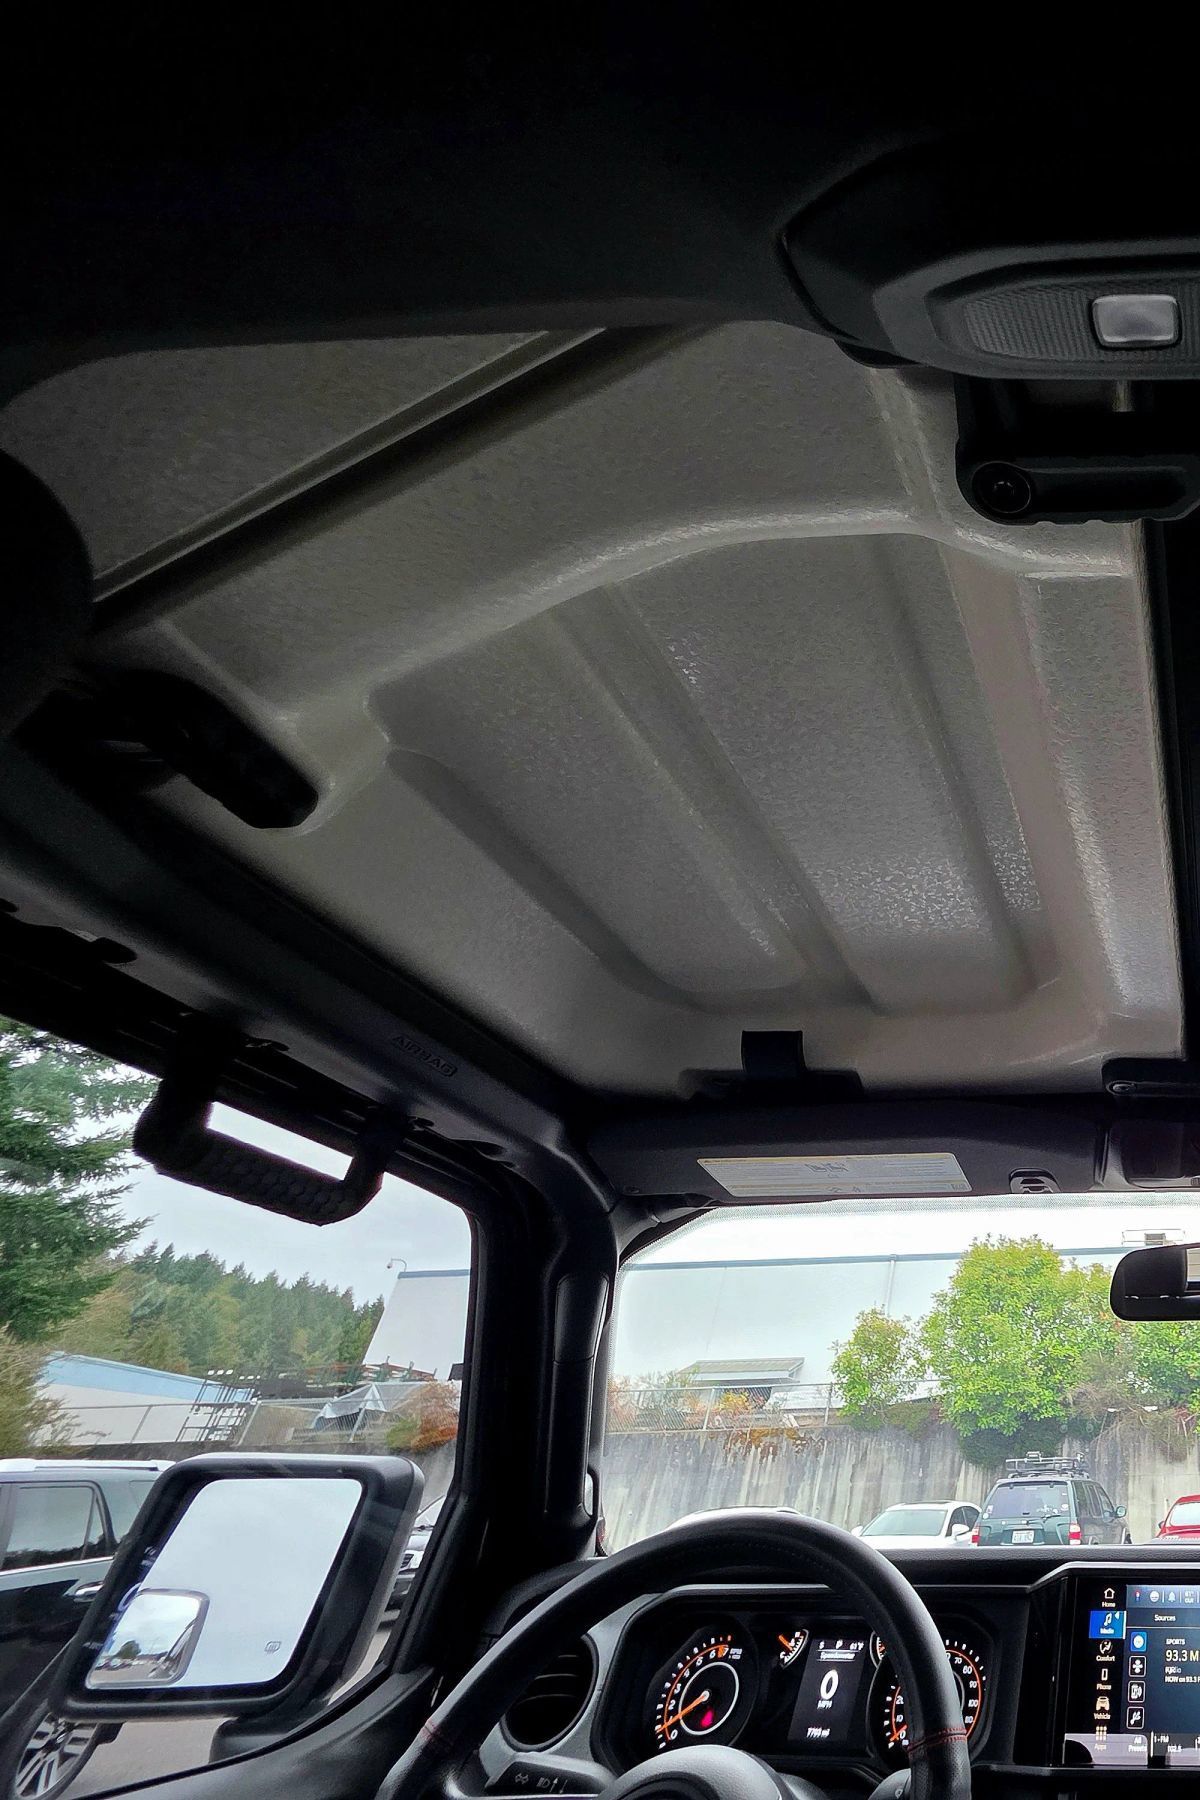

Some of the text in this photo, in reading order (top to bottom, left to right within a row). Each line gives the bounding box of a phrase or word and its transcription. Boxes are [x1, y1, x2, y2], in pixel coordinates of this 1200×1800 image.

[1154, 1614, 1176, 1622] Sources
[835, 1639, 843, 1651] P
[1165, 1638, 1186, 1646] SPORTS
[709, 1649, 717, 1660] 6
[820, 1651, 856, 1660] Speedometer
[1165, 1649, 1188, 1662] 93.3
[695, 1656, 704, 1667] 5
[954, 1656, 963, 1665] 70
[820, 1668, 839, 1700] 0
[969, 1680, 977, 1689] 90
[1096, 1683, 1112, 1691] Phone
[673, 1683, 682, 1695] 3
[667, 1699, 677, 1711] 2
[816, 1700, 833, 1710] MPH
[896, 1714, 904, 1723] 10
[1093, 1712, 1111, 1720] Vehicle
[670, 1728, 679, 1741] 0
[1094, 1743, 1107, 1751] Apps
